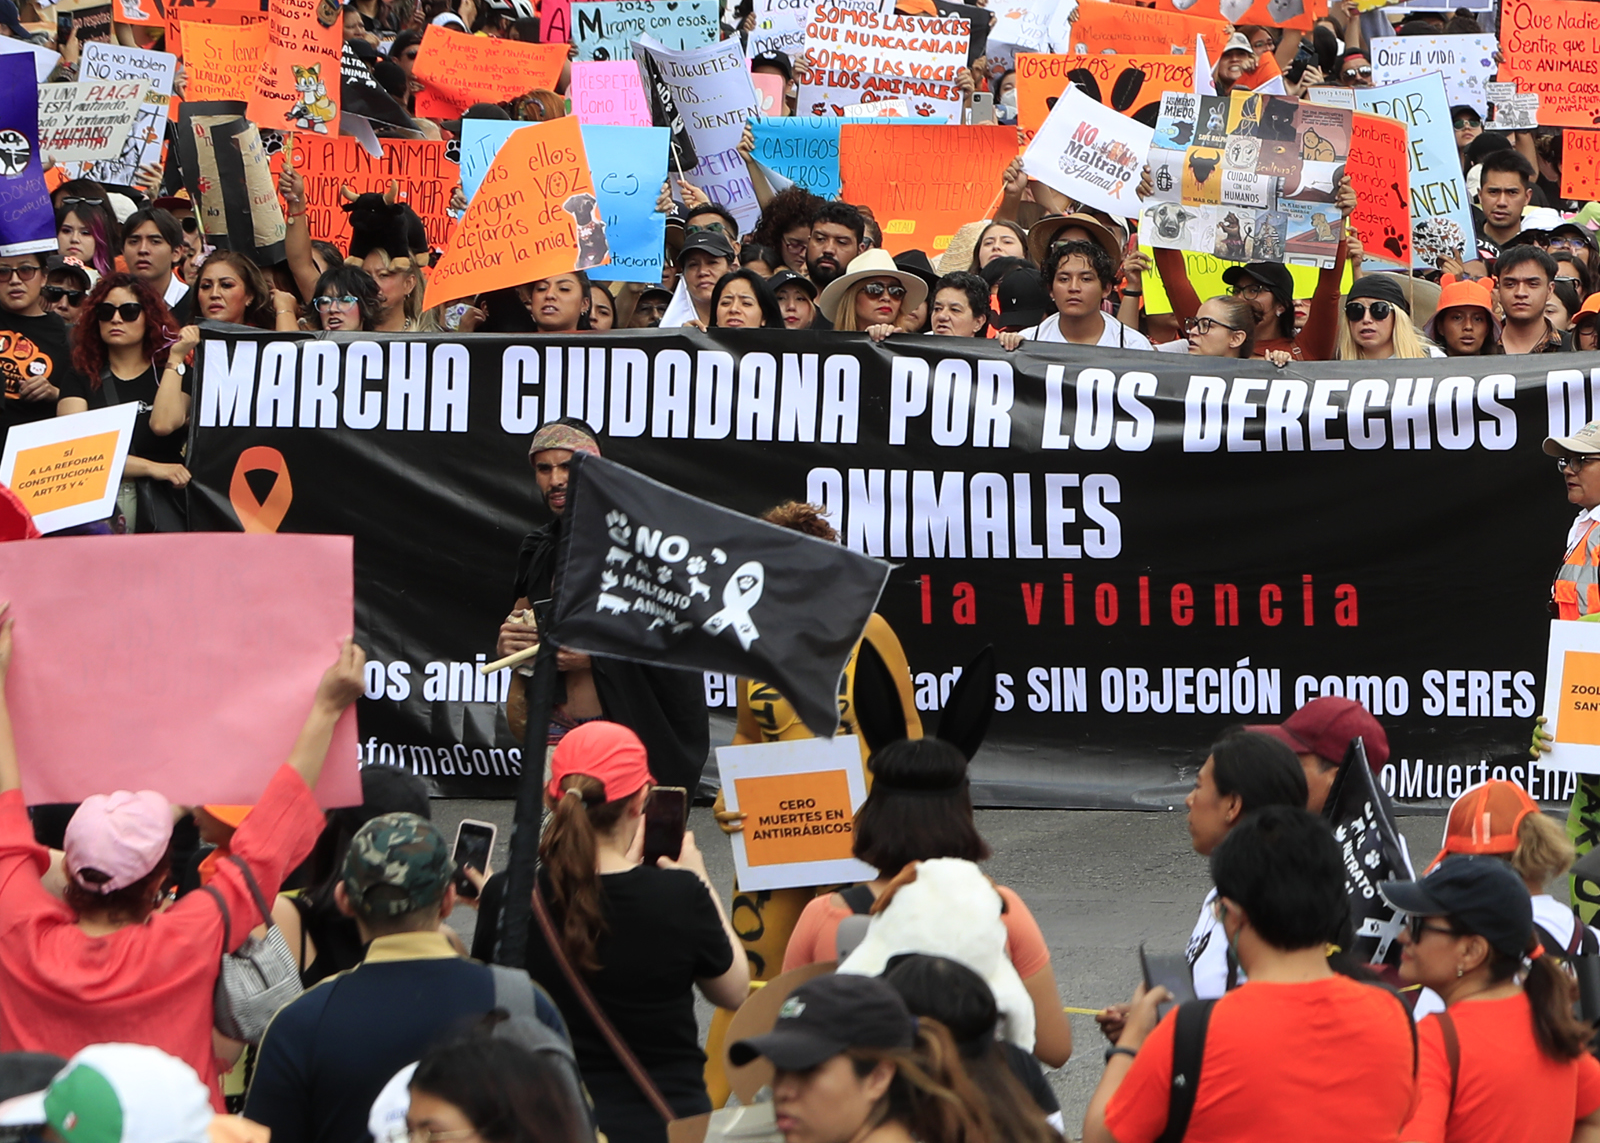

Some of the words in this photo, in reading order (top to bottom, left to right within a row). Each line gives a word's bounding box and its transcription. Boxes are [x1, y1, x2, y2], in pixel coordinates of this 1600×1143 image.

[616, 0, 655, 14] 2023
[1514, 2, 1552, 31] Que
[1558, 10, 1600, 29] Nadie
[650, 14, 672, 28] con
[815, 5, 879, 29] SOMOS
[883, 15, 915, 33] LAS
[918, 18, 971, 36] VOCES
[806, 23, 838, 42] QUE
[1509, 29, 1558, 55] Sentir
[1563, 38, 1586, 58] que
[129, 51, 167, 72] hablen
[805, 48, 867, 72] SOMOS
[873, 57, 906, 77] LAS
[1379, 49, 1404, 67] QUE
[1410, 50, 1422, 64] LA
[1429, 50, 1455, 64] VIDA
[1535, 59, 1598, 75] ANIMALES
[340, 66, 372, 80] ANIMAL
[1017, 55, 1116, 81] nosotros
[1129, 58, 1194, 88] somos
[53, 87, 77, 102] UNA
[86, 84, 140, 102] PLAGA
[863, 76, 961, 102] ANIMALES
[1538, 80, 1564, 93] una
[1544, 95, 1557, 104] NO
[1555, 103, 1590, 113] ANIMAL
[75, 113, 132, 127] torturando
[528, 142, 577, 172] ellos
[763, 138, 839, 159] CASTIGOS
[1063, 139, 1132, 183] Maltrato
[534, 168, 588, 200] VOZ
[1065, 161, 1116, 192] Animal
[1227, 171, 1258, 183] CUIDADO
[1224, 191, 1260, 203] HUMANOS
[456, 213, 529, 259] dejarás
[538, 201, 563, 227] de
[433, 246, 505, 286] escuchar
[513, 243, 531, 264] la
[200, 340, 470, 434] MARCHA
[500, 345, 860, 446] CIUDADANA
[887, 356, 1014, 448] POR
[1042, 363, 1159, 451] LOS
[1183, 373, 1518, 452] DERECHOS
[64, 447, 75, 458] SÍ
[40, 465, 52, 474] LA
[54, 454, 104, 470] REFORMA
[18, 464, 105, 490] CONSTITUCIONAL
[32, 486, 53, 498] ART
[55, 483, 67, 493] 73
[635, 525, 690, 563] NO
[623, 572, 692, 610] MALTRATO
[1021, 572, 1360, 628] violencia
[1028, 666, 1088, 714] SIN
[1100, 657, 1282, 716] OBJECIÓN
[1422, 669, 1537, 718] SERES
[779, 798, 816, 810] CERO
[759, 811, 824, 826] MUERTES
[826, 809, 844, 819] EN
[752, 822, 852, 840] ANTIRRÁBICOS
